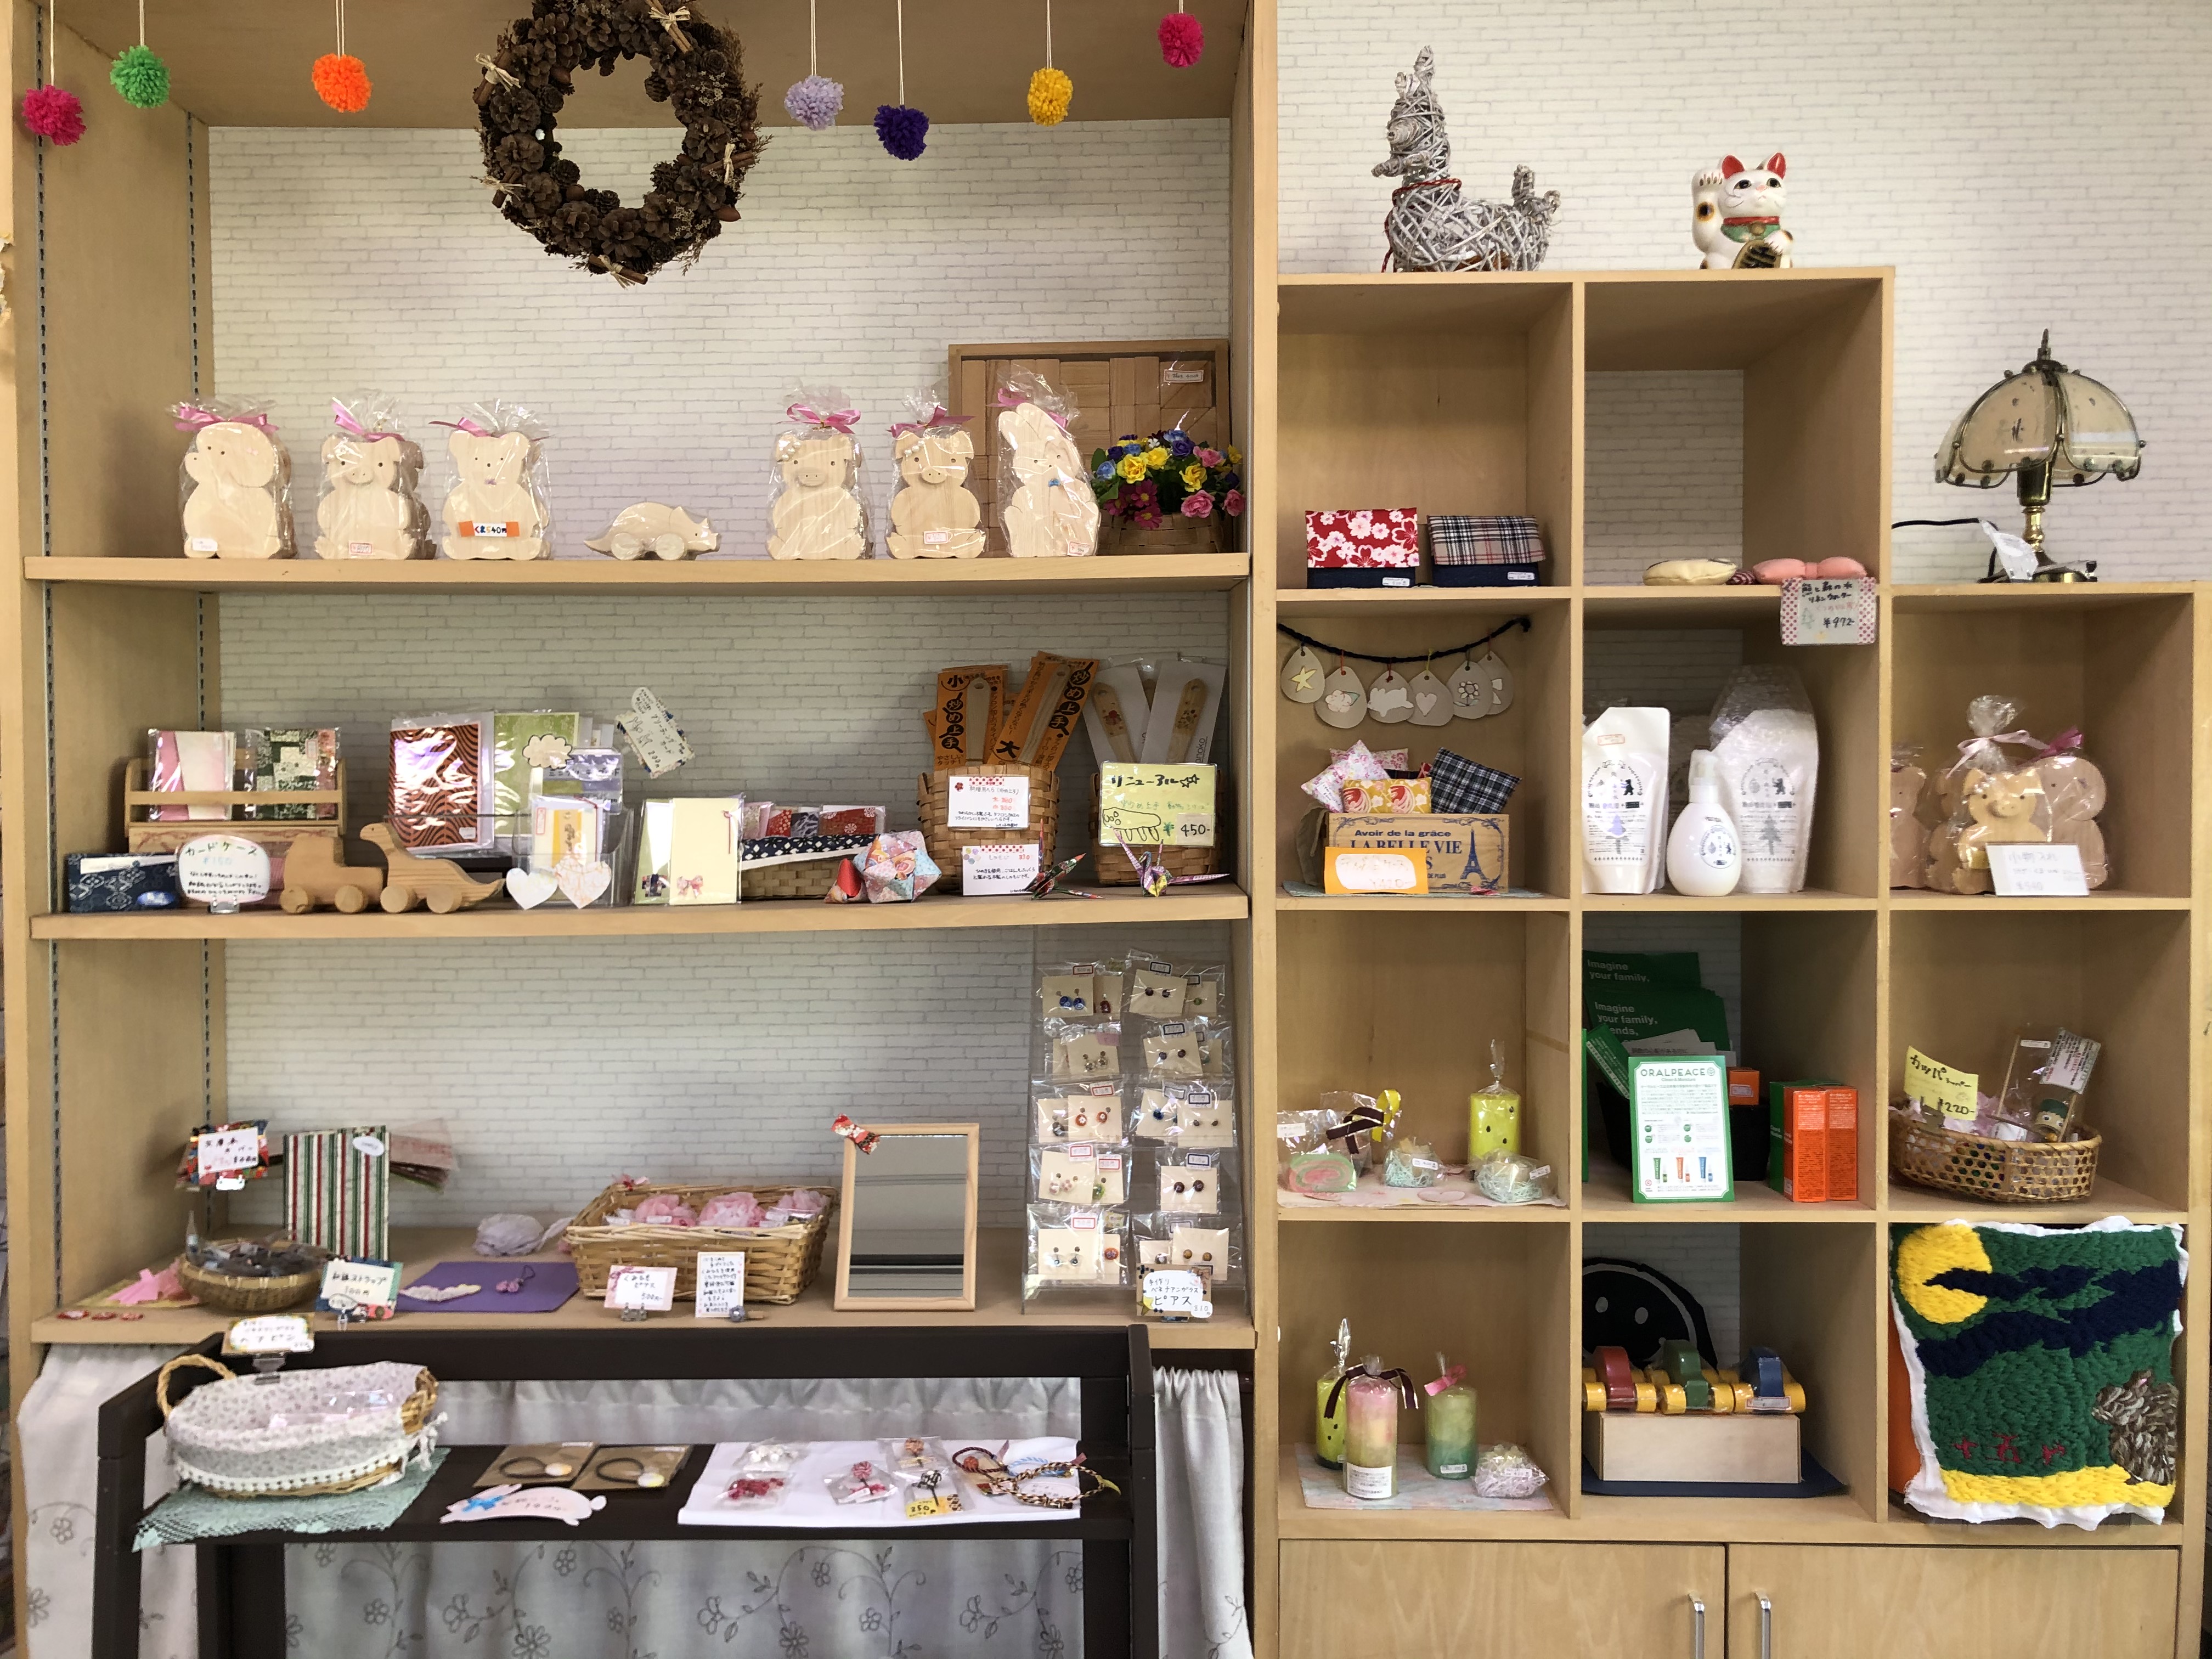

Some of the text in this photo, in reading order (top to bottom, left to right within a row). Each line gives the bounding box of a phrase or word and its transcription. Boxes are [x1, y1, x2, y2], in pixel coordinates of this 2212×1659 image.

[947, 674, 964, 689] 小
[1048, 669, 1091, 730] 炒め上手
[941, 698, 964, 750] 炒め上手
[996, 740, 1020, 759] 大
[185, 842, 257, 856] カードケース
[1434, 840, 1463, 854] VIE
[1587, 959, 1629, 972] Imagine
[1589, 971, 1611, 979] your
[1594, 1001, 1635, 1014] Imagine
[1597, 1014, 1619, 1023] your
[1610, 1027, 1639, 1036] ends,
[1640, 1068, 1706, 1077] ORALPEACE
[1149, 1278, 1170, 1286] 手作り
[1155, 1295, 1192, 1305] ピアス
